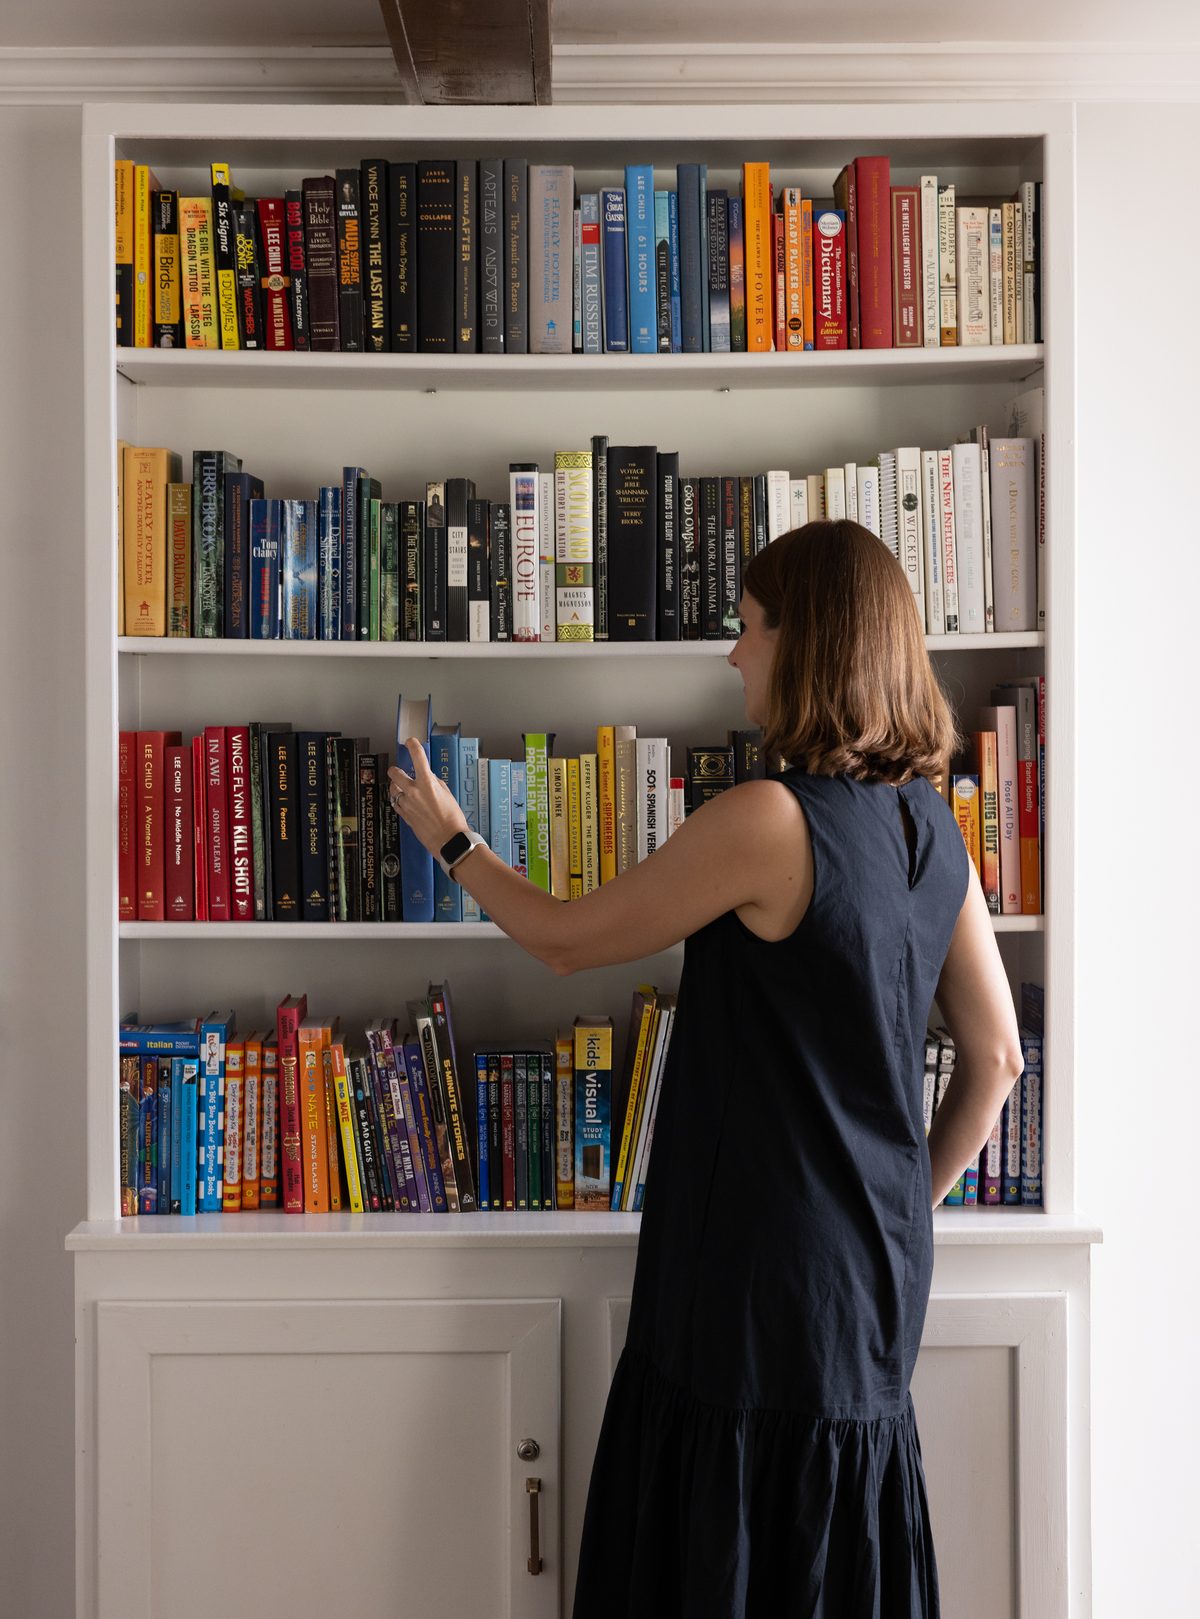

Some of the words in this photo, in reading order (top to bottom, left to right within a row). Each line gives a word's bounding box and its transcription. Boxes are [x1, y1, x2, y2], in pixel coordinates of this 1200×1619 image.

[367, 166, 378, 200] VINCE
[218, 202, 228, 216] Six
[288, 202, 302, 226] BAD
[309, 202, 330, 214] Holy
[310, 214, 330, 224] Bible
[368, 202, 380, 239] FLYNN
[512, 214, 520, 230] The
[199, 220, 208, 234] THE
[218, 218, 228, 252] Sigma
[268, 228, 279, 244] LEE
[789, 210, 798, 244] READY
[902, 213, 910, 255] INTELLIGENT
[1007, 222, 1013, 234] ON
[187, 228, 197, 260] DRAGON
[200, 238, 209, 256] GIRL
[236, 234, 246, 269] KOONTZ
[244, 240, 254, 264] DEAN
[289, 231, 304, 270] BLOOD
[370, 242, 382, 266] THE
[512, 234, 520, 264] Assault
[160, 256, 174, 290] Birds
[200, 259, 210, 279] WITH
[268, 247, 281, 272] CHILD
[512, 267, 517, 278] on
[585, 248, 598, 280] TIM
[790, 248, 798, 288] PLAYER
[904, 256, 912, 290] INVESTOR
[188, 264, 198, 292] TATTOO
[202, 282, 211, 296] THE
[370, 269, 382, 299] LAST
[820, 238, 834, 319] Dictionary
[223, 280, 234, 332] DUMMIES
[512, 282, 520, 312] Reason
[791, 294, 800, 314] ONE
[190, 304, 200, 340] LARSSON
[202, 304, 212, 326] STIEG
[371, 300, 384, 328] MAN
[586, 284, 599, 352] RUSSERT
[942, 456, 950, 478] THE
[145, 480, 154, 530] HARRY
[942, 482, 952, 508] NEW
[557, 514, 565, 522] OF
[568, 472, 590, 558] SCOTLAND
[665, 512, 672, 520] TO
[708, 515, 716, 535] THE
[174, 520, 186, 550] DAVID
[261, 539, 278, 550] Tom
[330, 526, 340, 558] Daniel
[408, 534, 417, 548] THE
[726, 528, 734, 540] THE
[906, 516, 916, 572] WICKED
[944, 512, 954, 584] INFLUENCERS
[145, 536, 154, 584] POTTER
[253, 547, 278, 560] Clancy
[408, 548, 417, 579] TESTAMENT
[516, 516, 535, 601] EUROPE
[708, 538, 716, 573] MORAL
[726, 542, 735, 564] BILLION
[174, 554, 186, 602] BALDACCI
[726, 566, 735, 588] DOLLAR
[708, 576, 716, 615] ANIMAL
[726, 590, 736, 602] SPY
[208, 740, 220, 752] IN
[232, 734, 244, 774] VINCE
[1024, 723, 1032, 760] Designing
[210, 757, 220, 786] AWE
[308, 760, 316, 786] CHILD
[537, 747, 548, 772] THE
[279, 764, 287, 790] CHILD
[526, 747, 536, 811] PROBLEM
[176, 806, 182, 816] No
[233, 777, 244, 818] FLYNN
[984, 791, 996, 819] BUG
[212, 808, 220, 834] JOHN
[280, 808, 288, 840] Personal
[308, 802, 316, 825] Night
[537, 778, 549, 861] THREE-BODY
[234, 825, 248, 854] KILL
[310, 828, 318, 854] School
[513, 822, 526, 844] LADY
[985, 825, 998, 854] OUT
[1005, 822, 1014, 840] Day
[235, 857, 250, 895] SHOT
[424, 1042, 437, 1088] DINOTOPIA
[586, 1038, 600, 1066] kids
[308, 1094, 318, 1130] NATE
[444, 1060, 457, 1112] 5-MINUTE
[452, 1114, 464, 1160] STORIES
[585, 1072, 602, 1124] visual
[362, 1122, 370, 1138] BAD
[206, 1145, 216, 1174] Beginner
[364, 1140, 372, 1163] GUYS
[400, 1140, 408, 1154] CAT
[403, 1156, 414, 1180] NINJA
